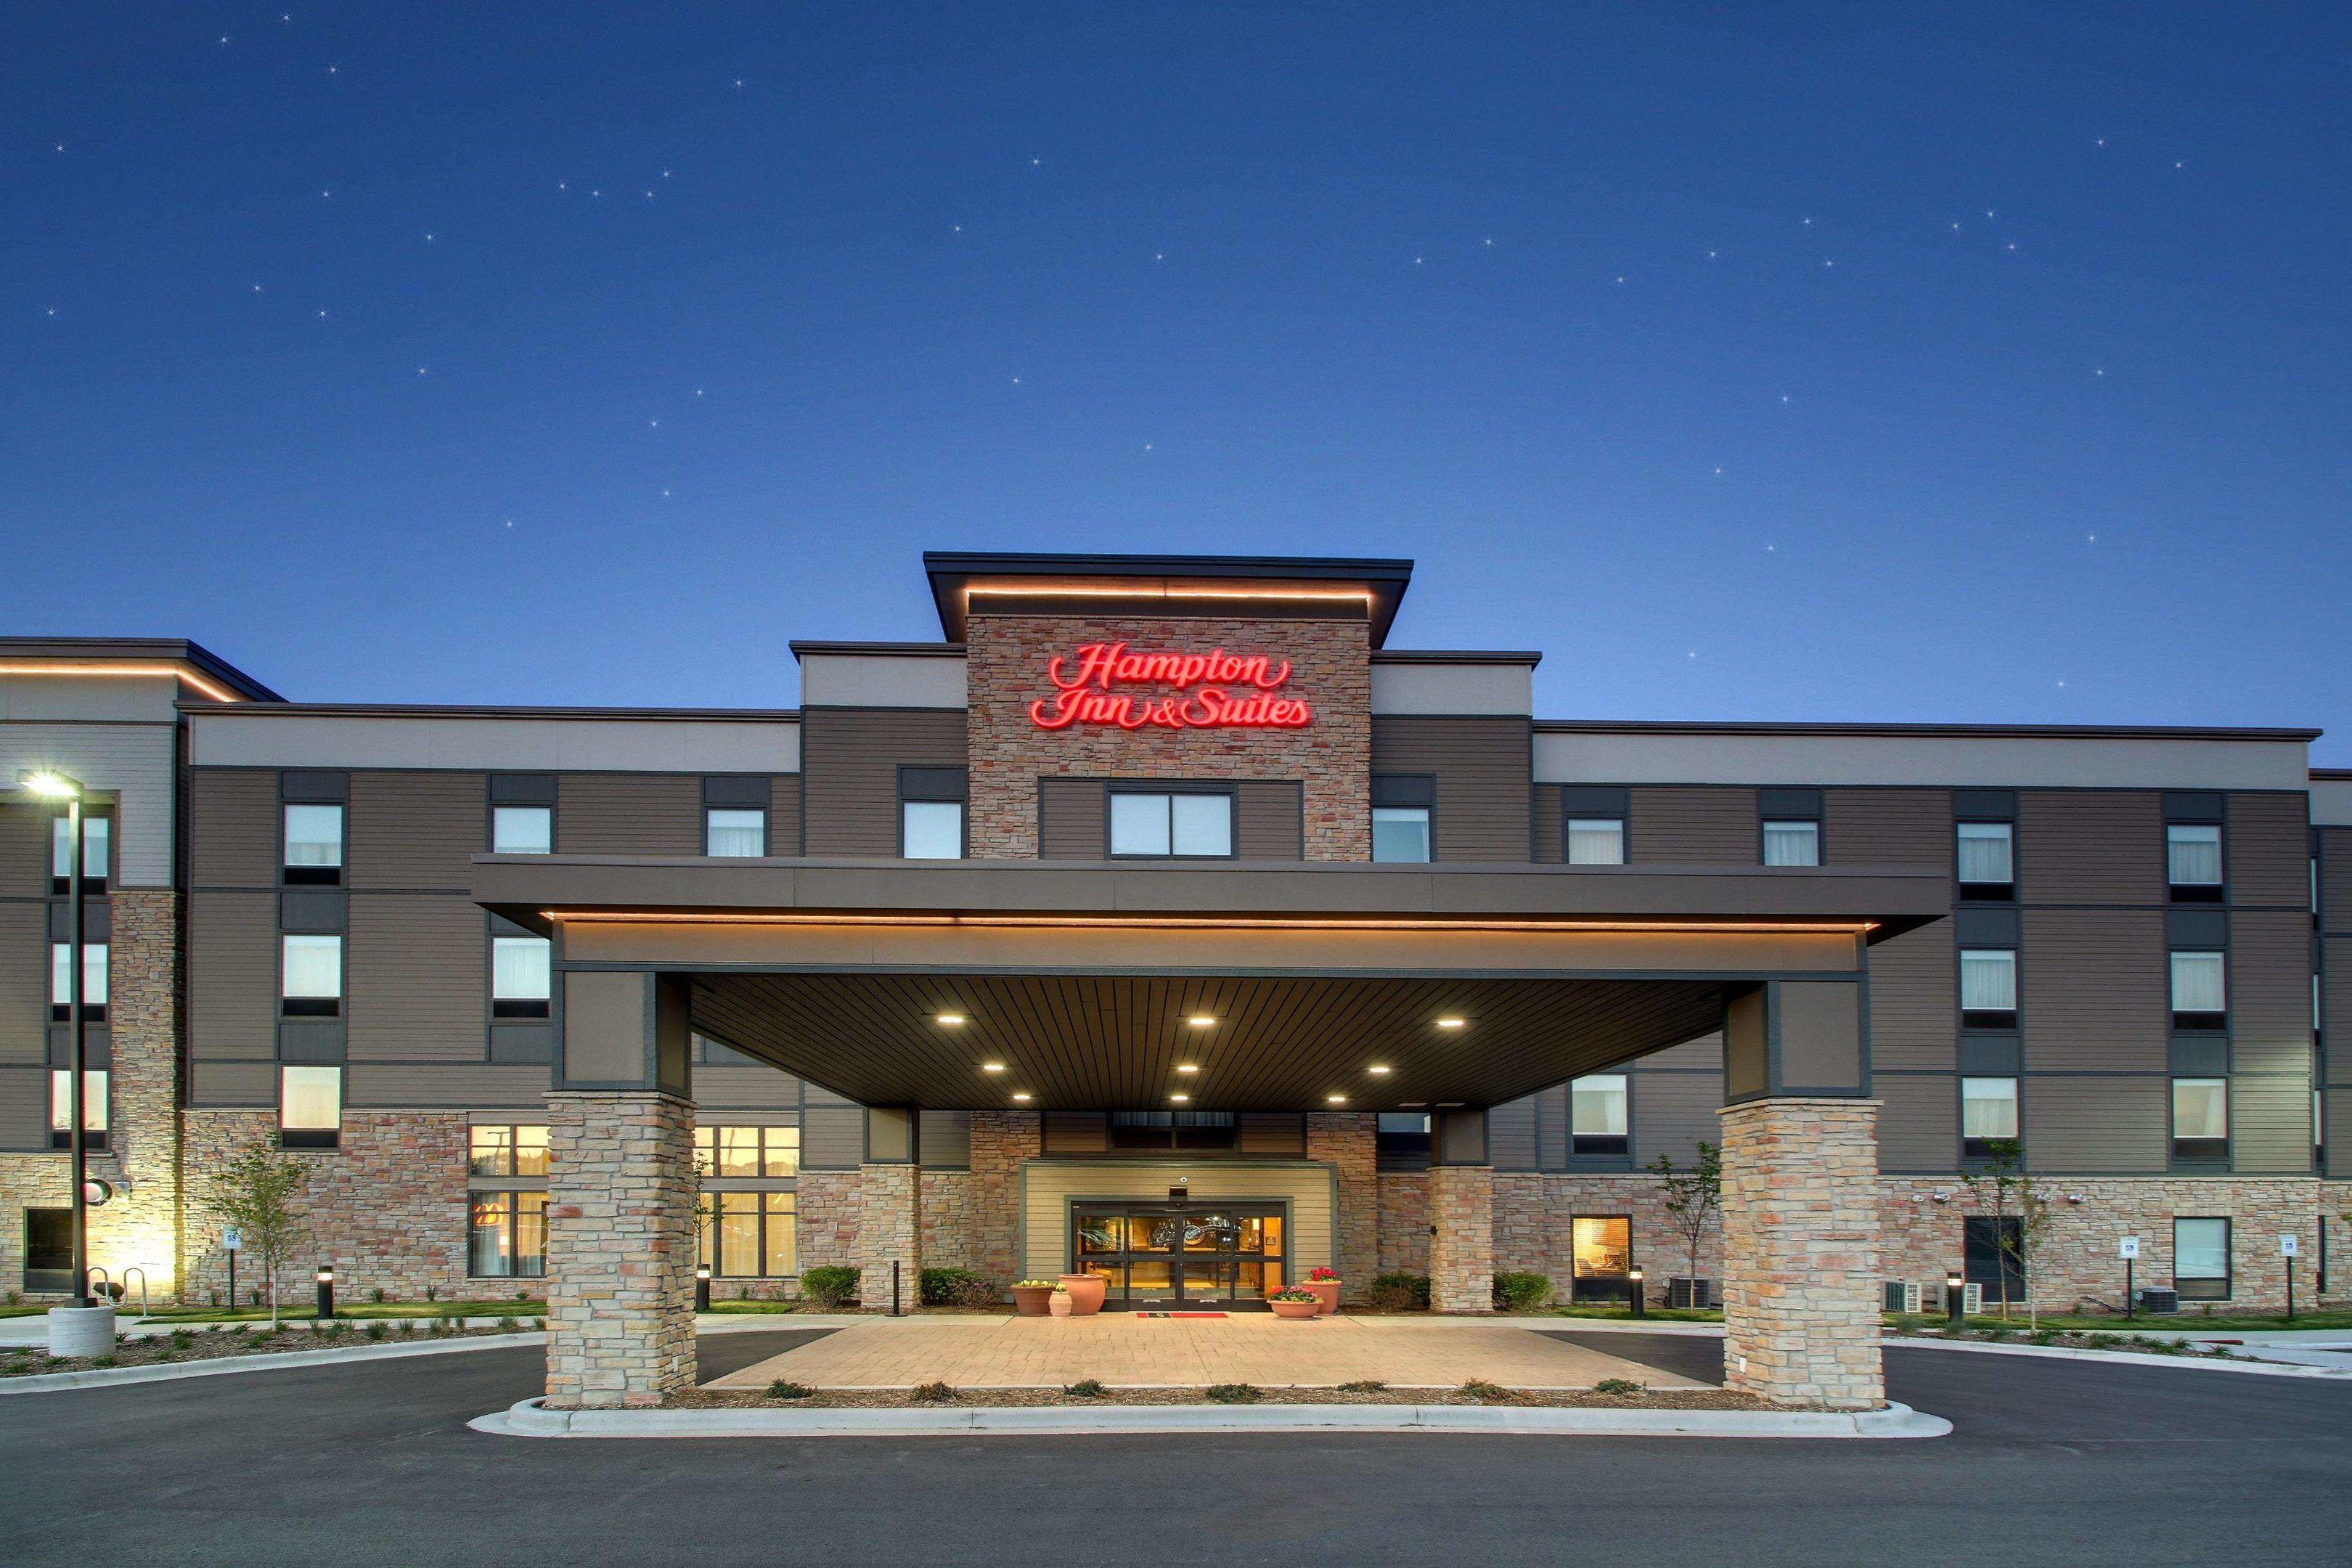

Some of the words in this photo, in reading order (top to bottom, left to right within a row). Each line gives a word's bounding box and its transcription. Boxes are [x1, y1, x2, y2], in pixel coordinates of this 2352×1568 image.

[1050, 642, 1290, 690] Hampton
[1030, 688, 1152, 728] Inn
[1153, 699, 1184, 728] &
[1180, 687, 1311, 728] Suites
